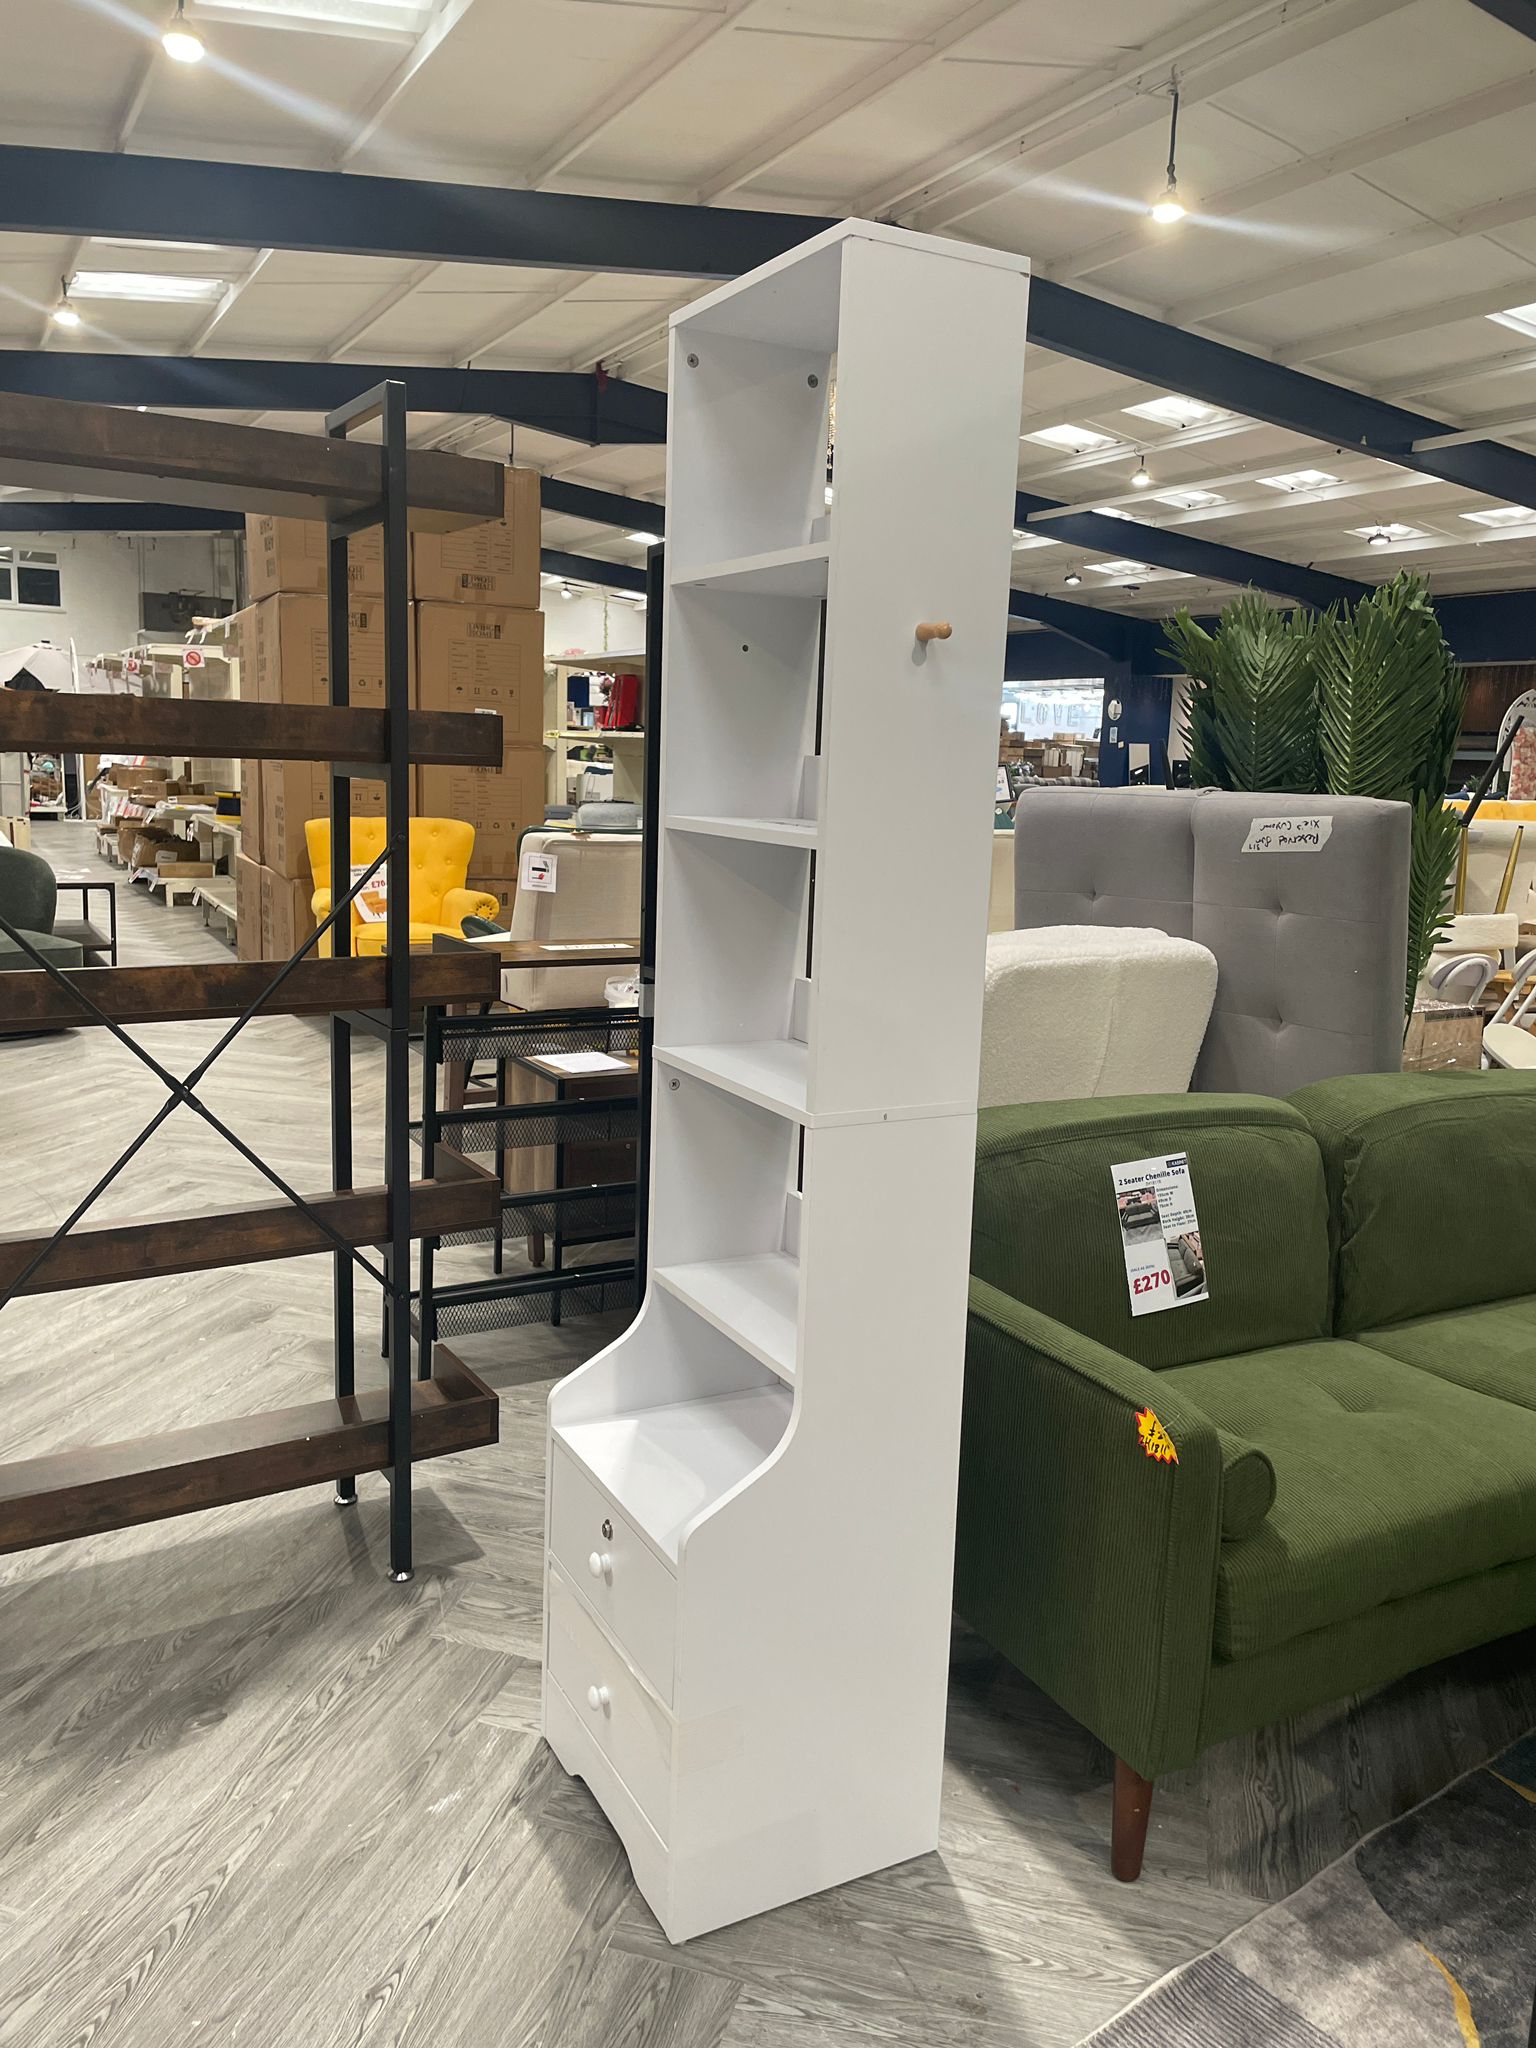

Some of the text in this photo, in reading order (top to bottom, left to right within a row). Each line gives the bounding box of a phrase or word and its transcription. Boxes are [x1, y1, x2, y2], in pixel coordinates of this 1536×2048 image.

[1020, 702, 1078, 727] LOVE
[1278, 833, 1319, 845] Reserved
[1124, 1175, 1144, 1185] Seater
[1145, 1171, 1171, 1180] Chenille
[1171, 1168, 1185, 1176] Sofa
[1133, 1269, 1170, 1295] £270
